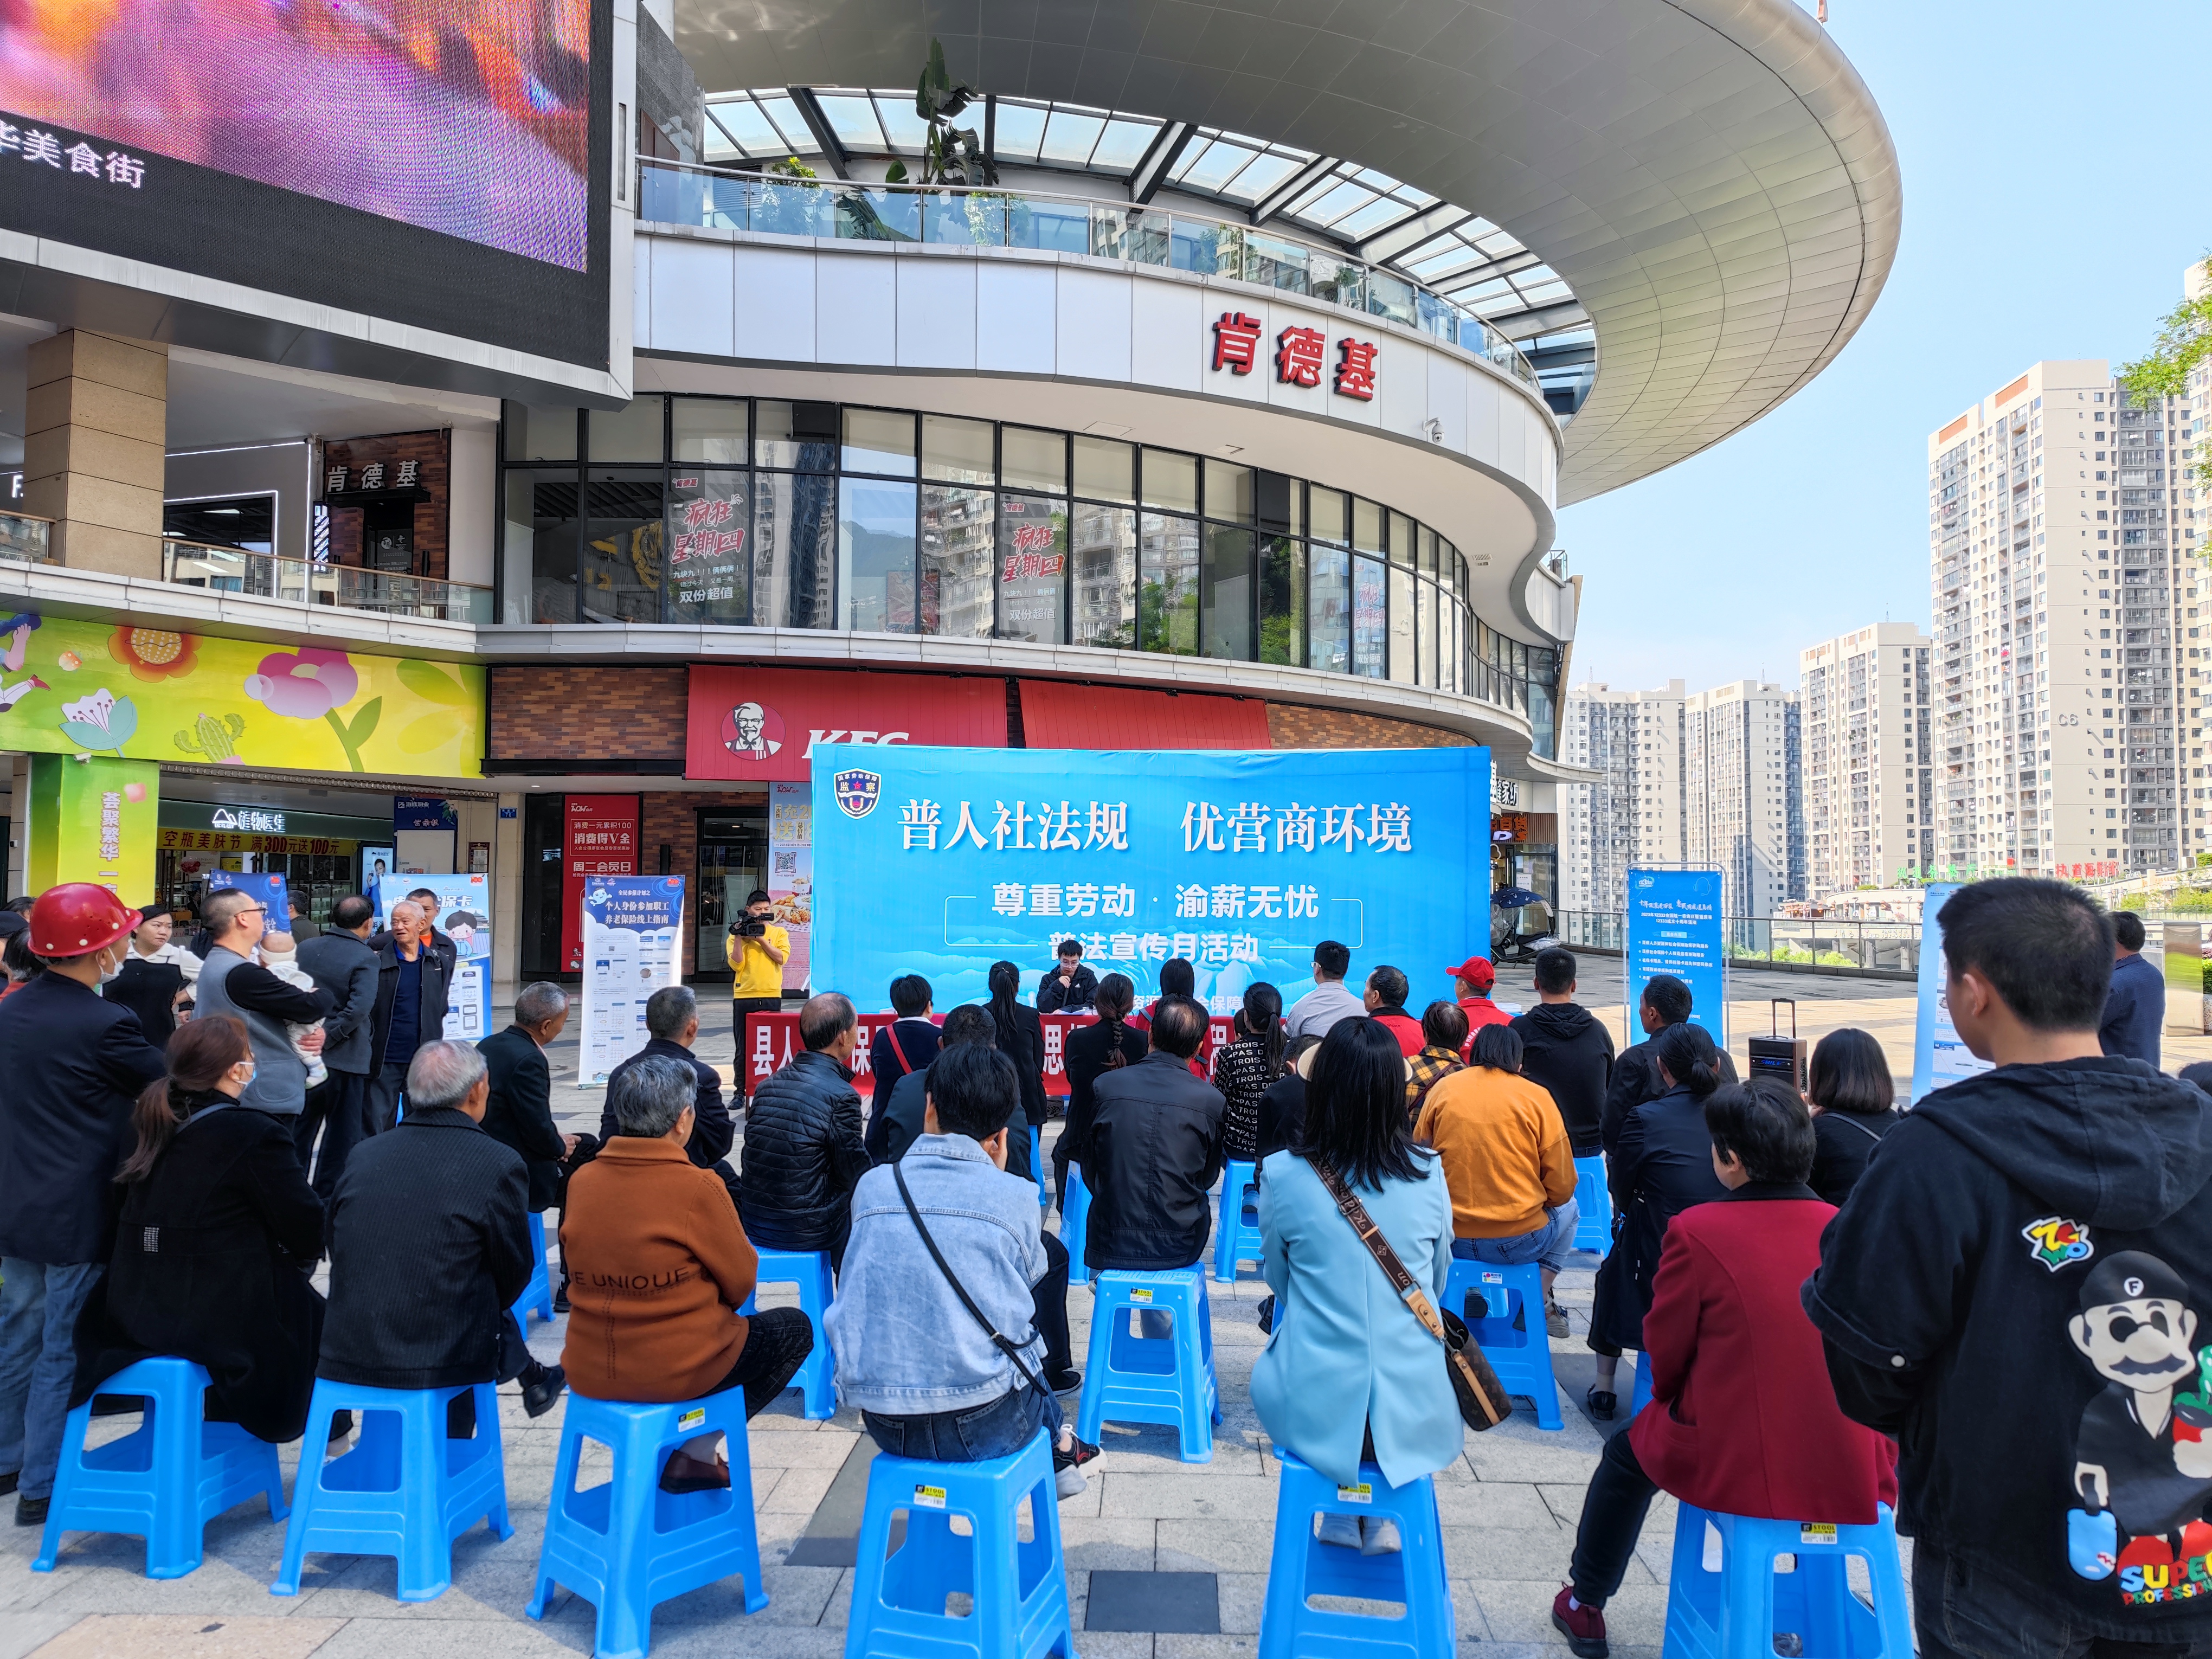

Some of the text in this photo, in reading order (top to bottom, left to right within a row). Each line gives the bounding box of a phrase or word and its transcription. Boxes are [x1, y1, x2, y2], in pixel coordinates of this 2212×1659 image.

[1212, 312, 1378, 402] 肯德基
[327, 460, 419, 492] 肯德基
[684, 498, 734, 532] 疯狂
[1012, 522, 1054, 554] 疯狂
[671, 529, 745, 564] 星期四
[1001, 552, 1065, 584] 星期四
[679, 587, 734, 603] 双份超值
[1009, 608, 1056, 621] 双份超值
[2057, 712, 2078, 725] C6
[99, 791, 121, 861] 荟聚繁华
[239, 811, 286, 832] 植物医生
[897, 799, 1412, 853] 普人社法规 优营商环境
[163, 830, 339, 854] 空瓶美肤节 满300元送100元
[574, 833, 631, 844] 消费得V金
[573, 861, 631, 872] 周二会员日
[605, 901, 669, 911] 个人身份参加职工
[605, 914, 669, 924] 养老保险线上指南
[1229, 1042, 1258, 1051] TROIS
[1232, 1050, 1253, 1058] PAS
[1233, 1057, 1261, 1066] TROIS
[1236, 1066, 1256, 1075] PAS
[1236, 1074, 1263, 1083] TROIS
[1239, 1107, 1258, 1116] TROI
[1237, 1136, 1256, 1147] TROI
